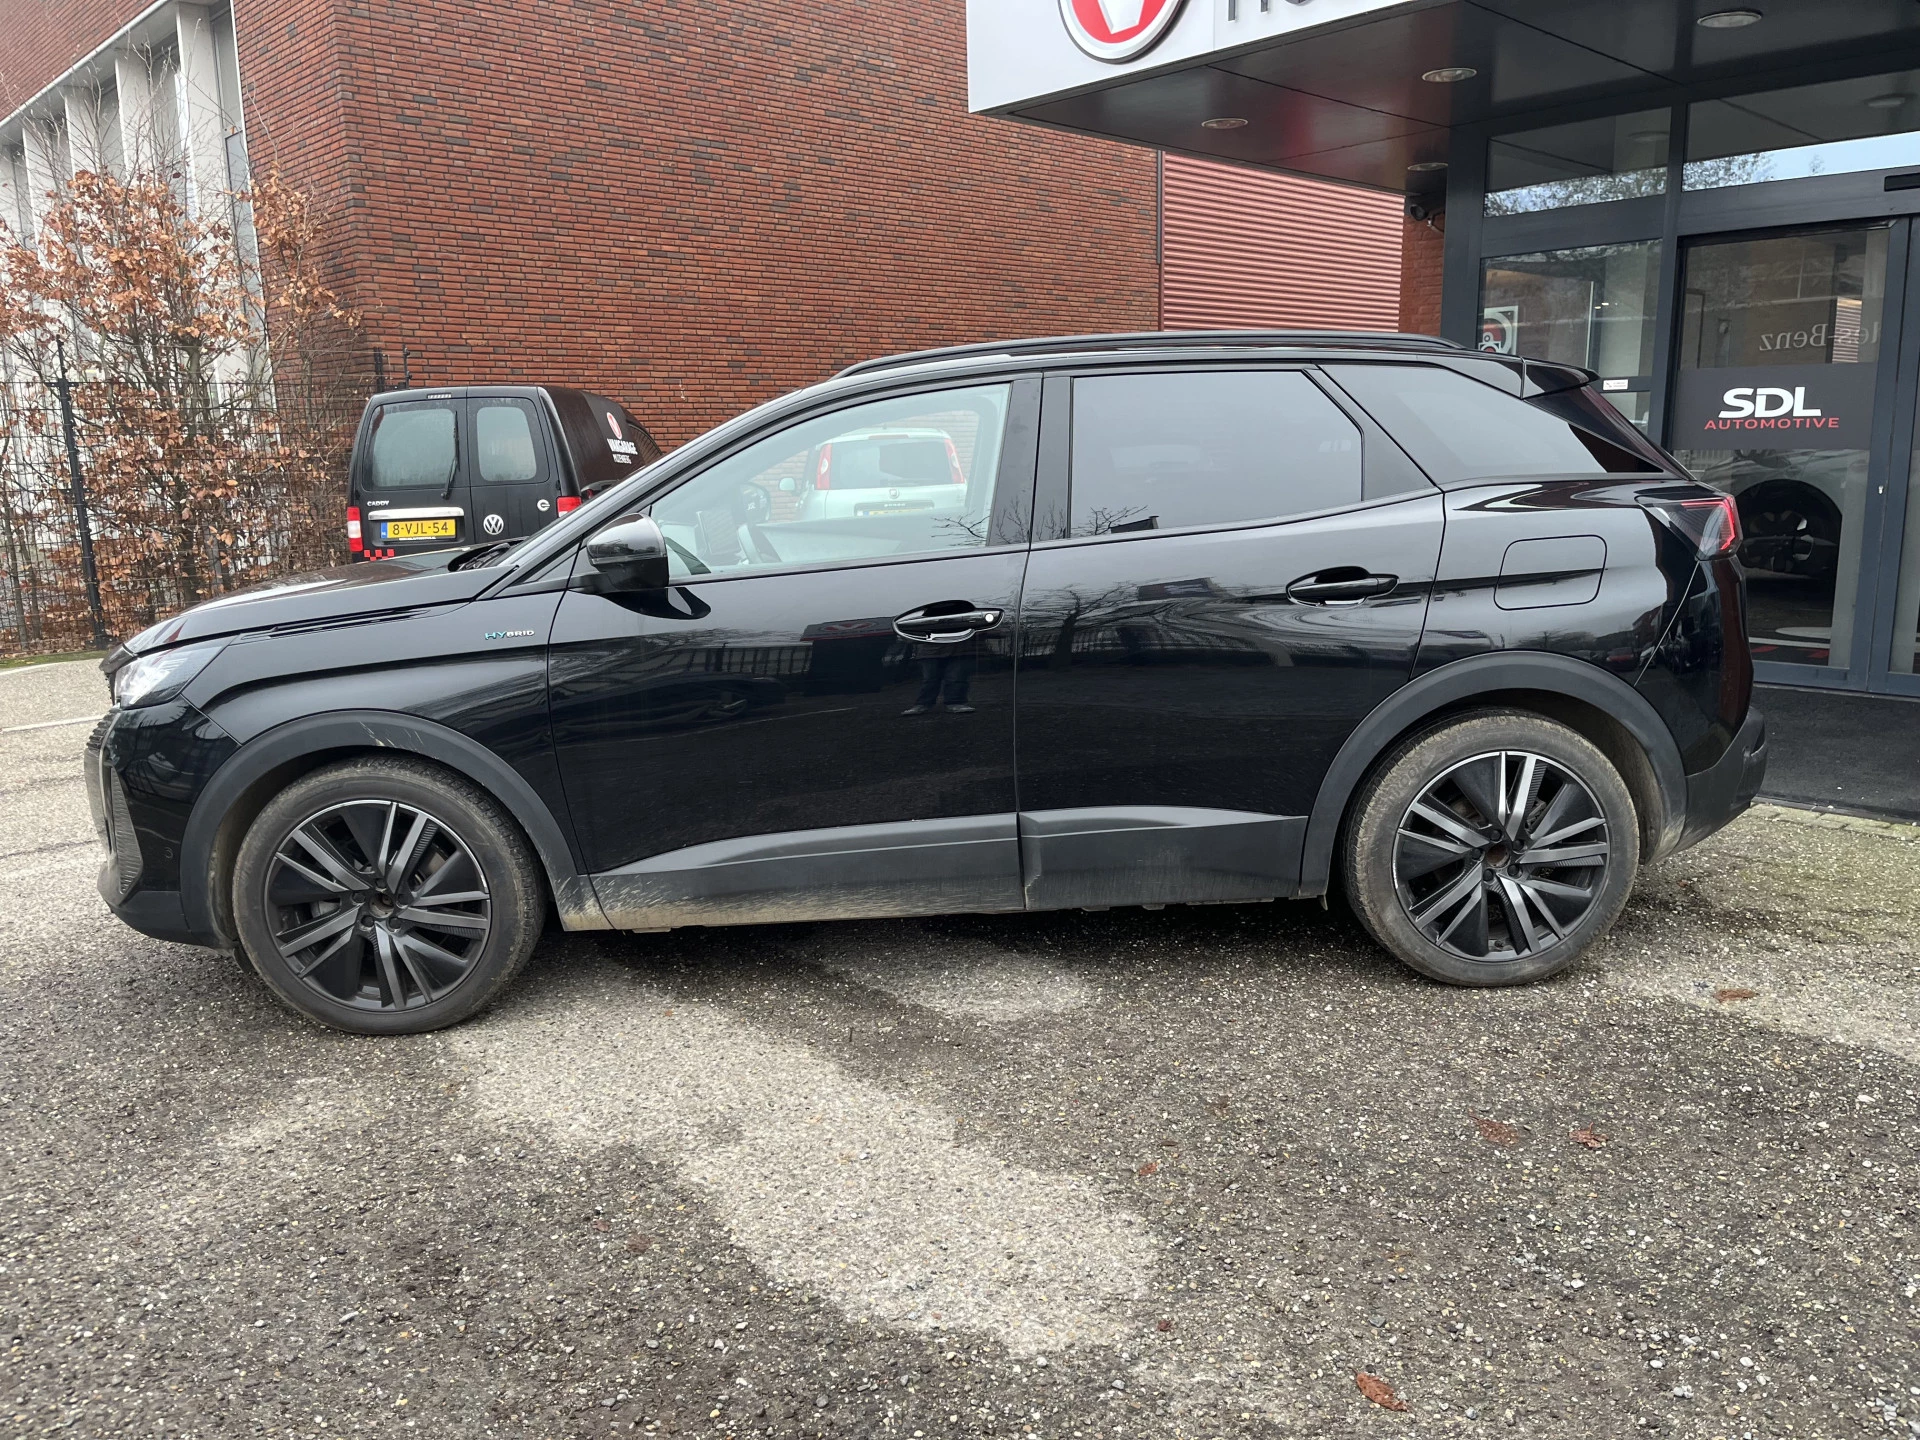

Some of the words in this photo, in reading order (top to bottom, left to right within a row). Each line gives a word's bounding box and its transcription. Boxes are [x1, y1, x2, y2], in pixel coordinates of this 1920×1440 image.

[1718, 386, 1822, 419] SDL
[1704, 417, 1840, 430] AUTOMOTIVE
[393, 522, 448, 536] 8-VJL-54
[485, 630, 535, 640] HYBRID
